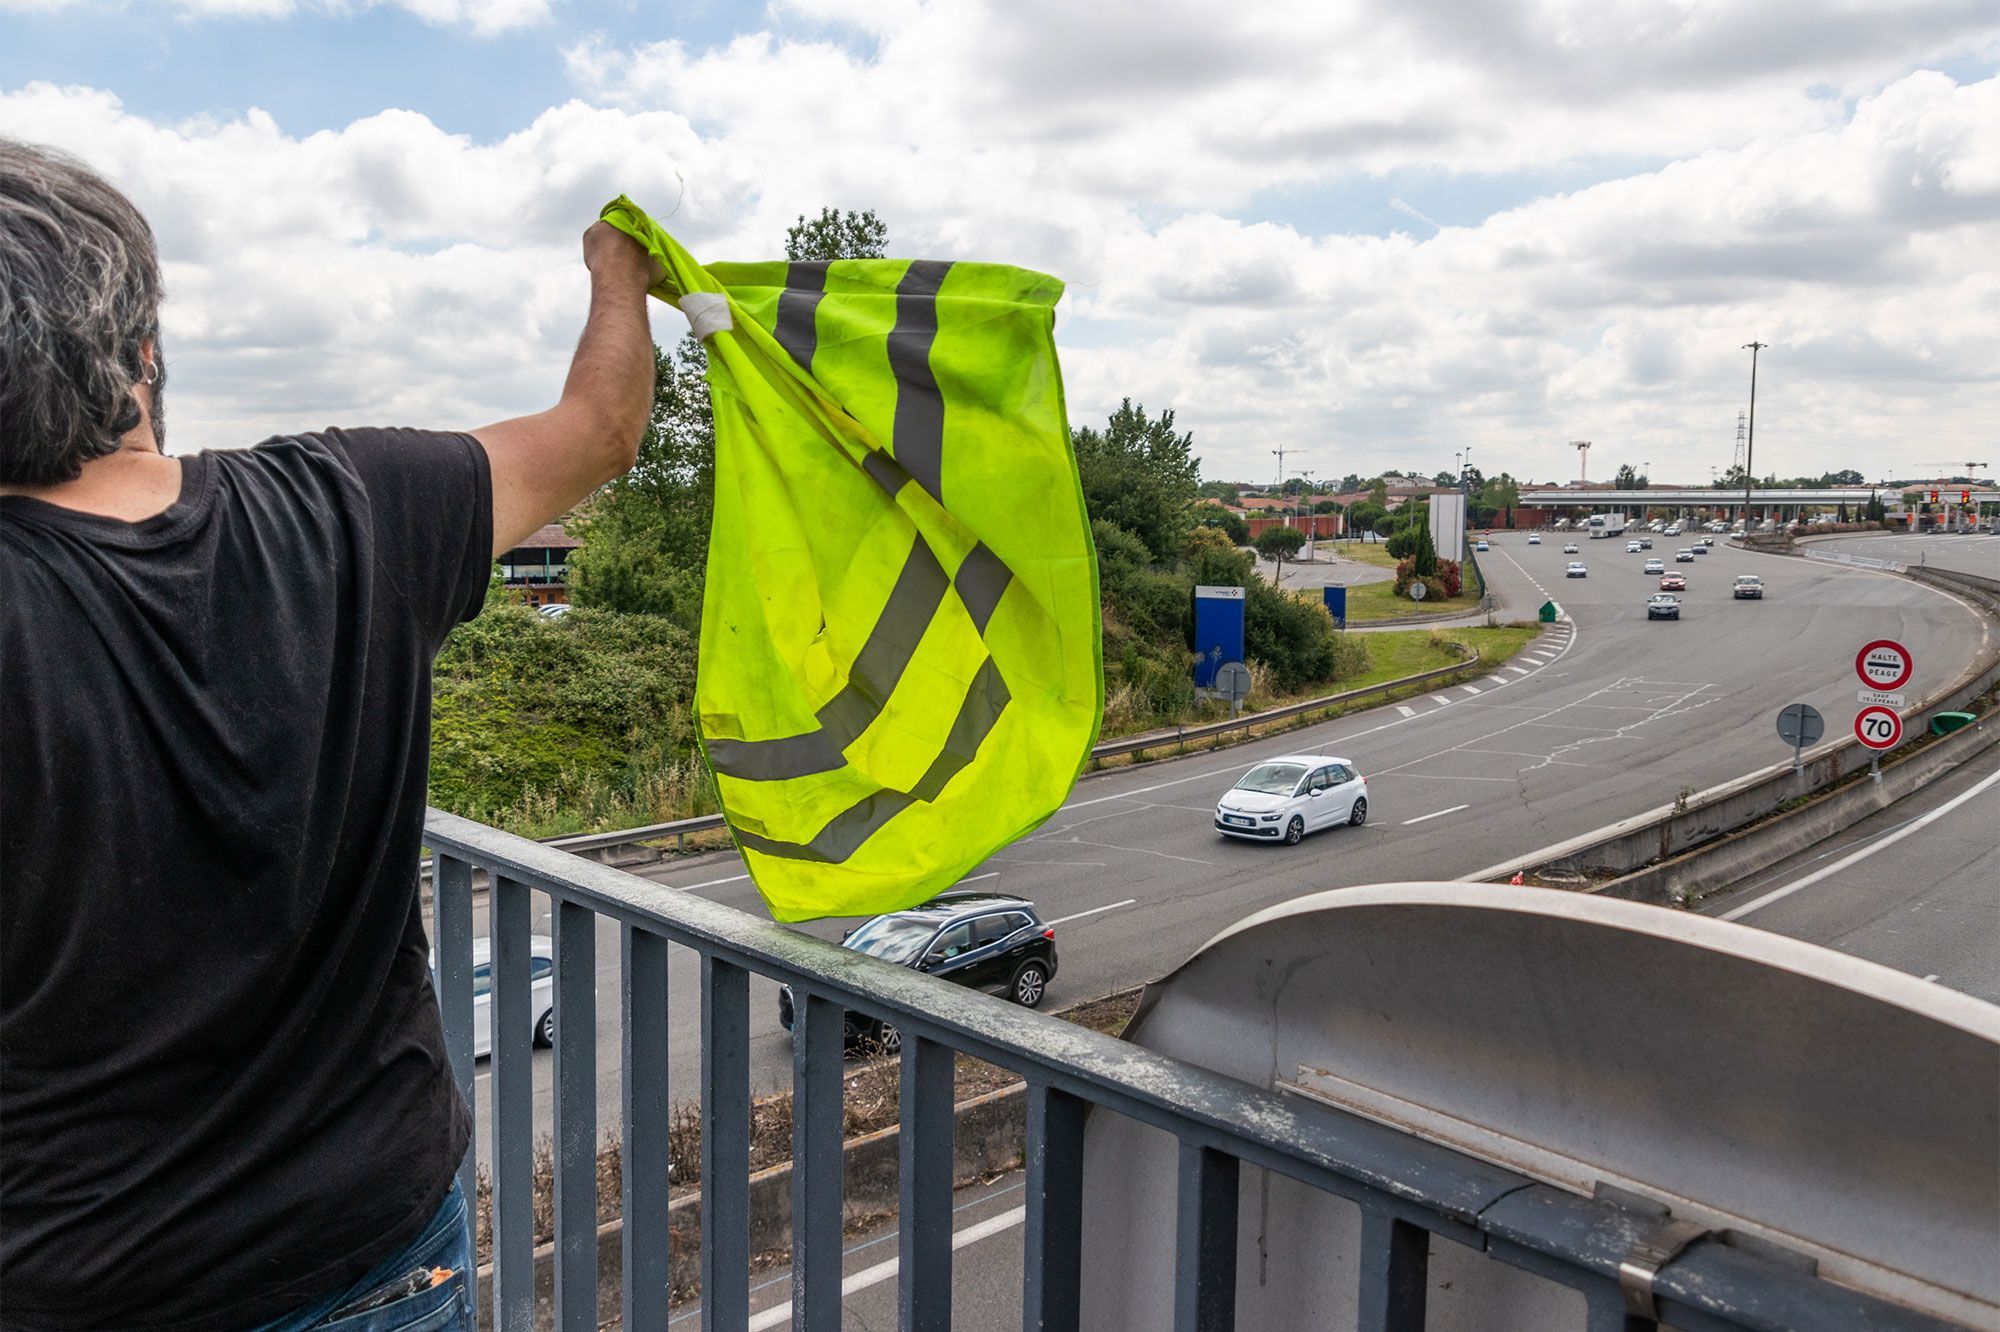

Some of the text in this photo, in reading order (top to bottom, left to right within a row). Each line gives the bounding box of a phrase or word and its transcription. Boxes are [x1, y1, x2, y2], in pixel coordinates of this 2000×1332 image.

[1871, 654, 1898, 662] HALTE
[1869, 668, 1898, 678] PÉAGE
[1866, 718, 1892, 738] 70
